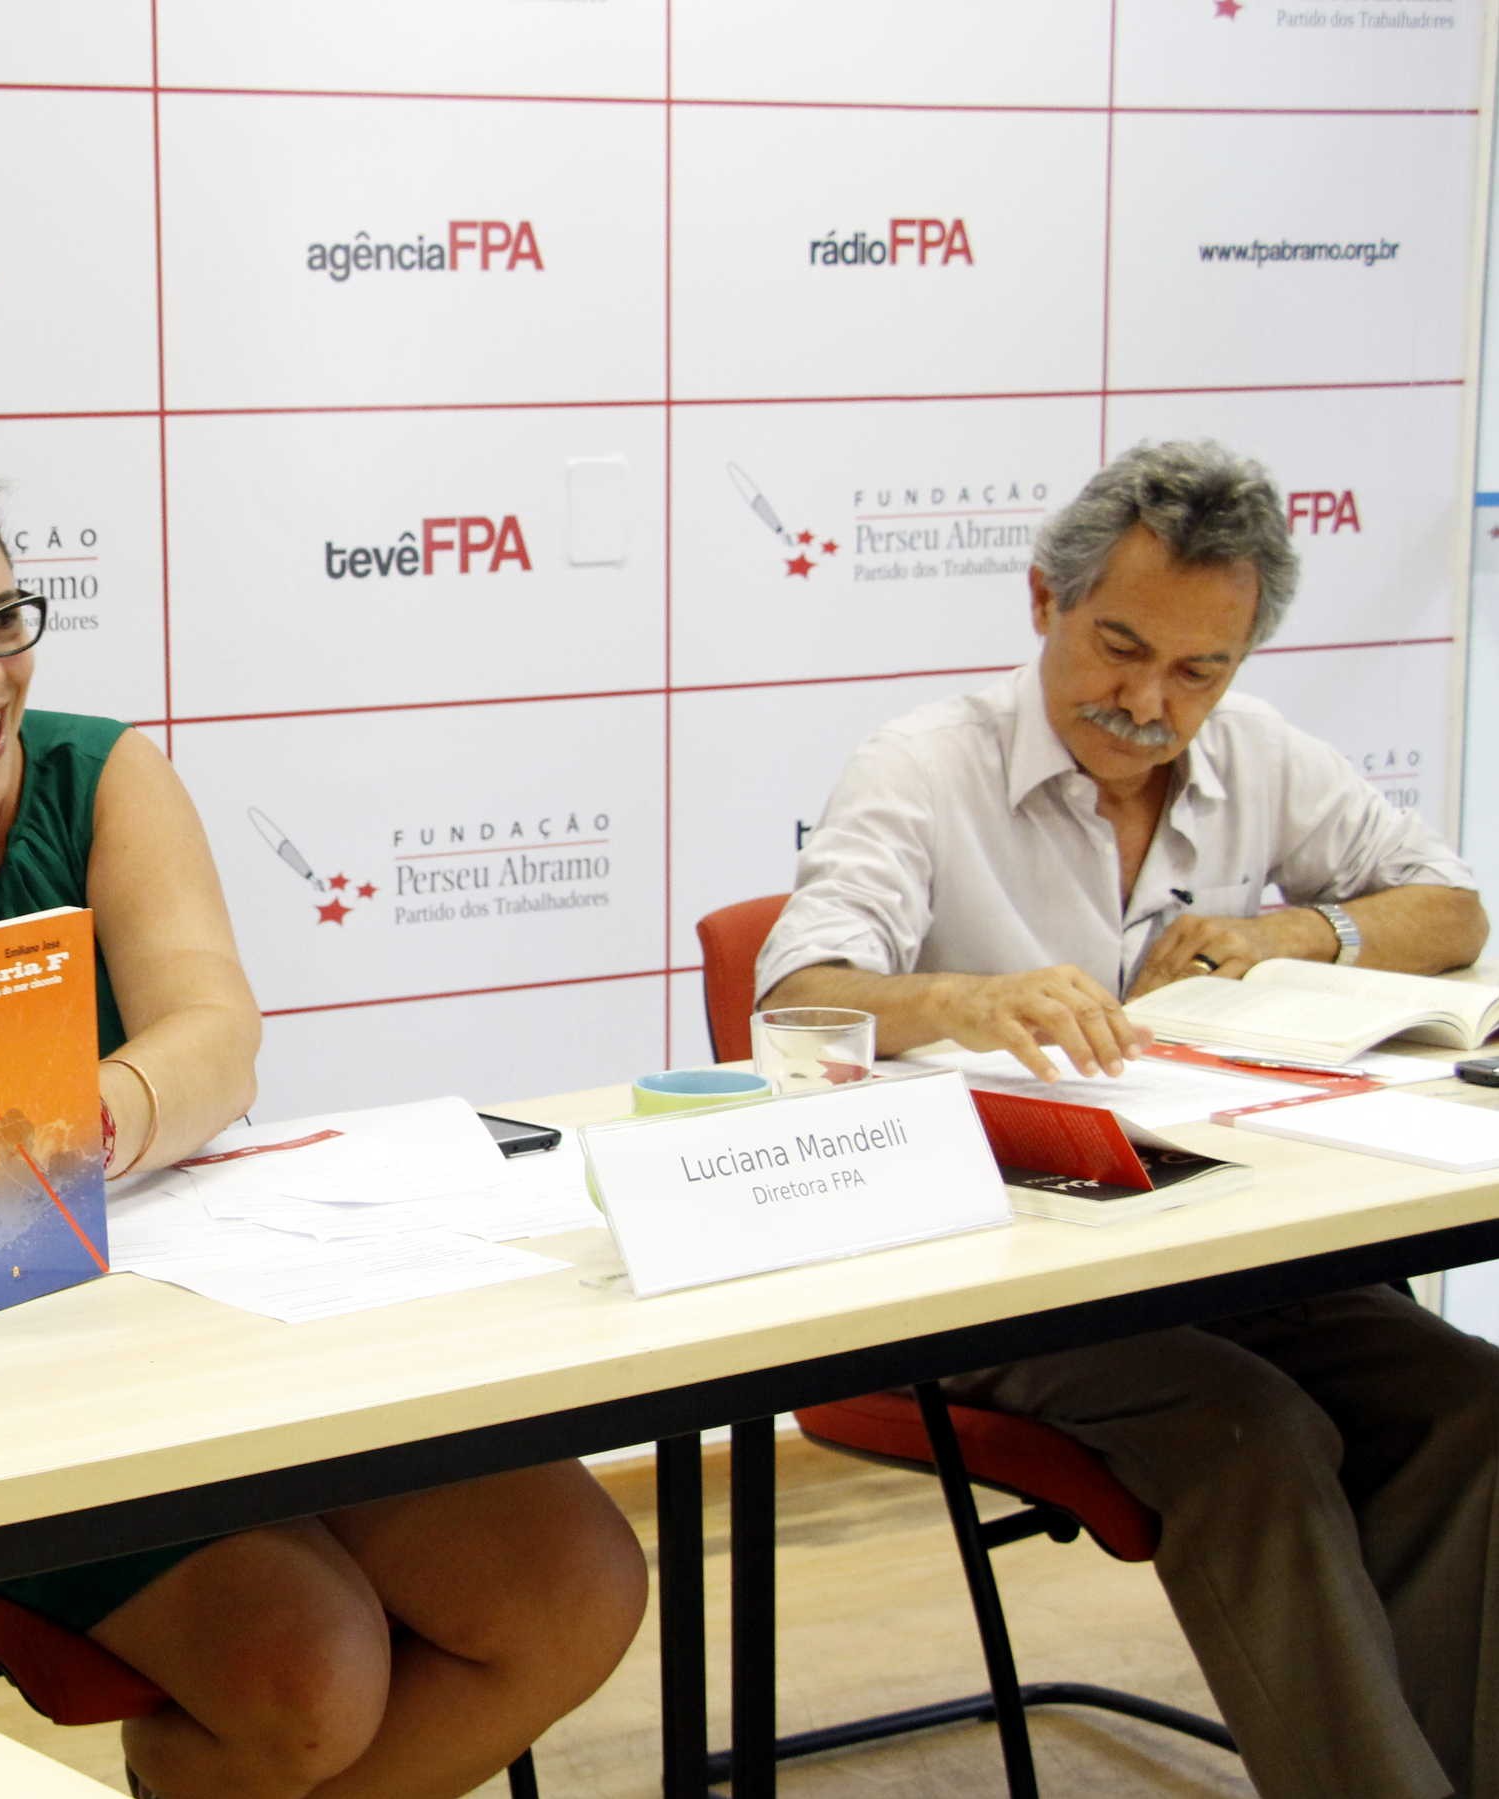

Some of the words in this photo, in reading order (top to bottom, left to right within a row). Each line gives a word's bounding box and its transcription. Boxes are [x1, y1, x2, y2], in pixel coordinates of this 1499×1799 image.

[1330, 10, 1355, 28] dos
[1199, 238, 1400, 269] www.fpabramo.org.br
[855, 523, 939, 555] Perseu
[947, 519, 1033, 550] Abram
[853, 562, 908, 582] Partido
[913, 561, 938, 579] dos
[941, 557, 1030, 578] Trabalhador
[396, 862, 490, 896] Perseu
[499, 850, 610, 887] Abramo
[394, 901, 456, 925] Partido
[460, 899, 489, 920] dos
[496, 891, 610, 917] Trabalhadores
[46, 951, 70, 972] F
[680, 1142, 790, 1183] Luciana
[795, 1118, 909, 1163] Mandelli
[752, 1174, 829, 1206] Diretora
[831, 1167, 867, 1191] FPA
